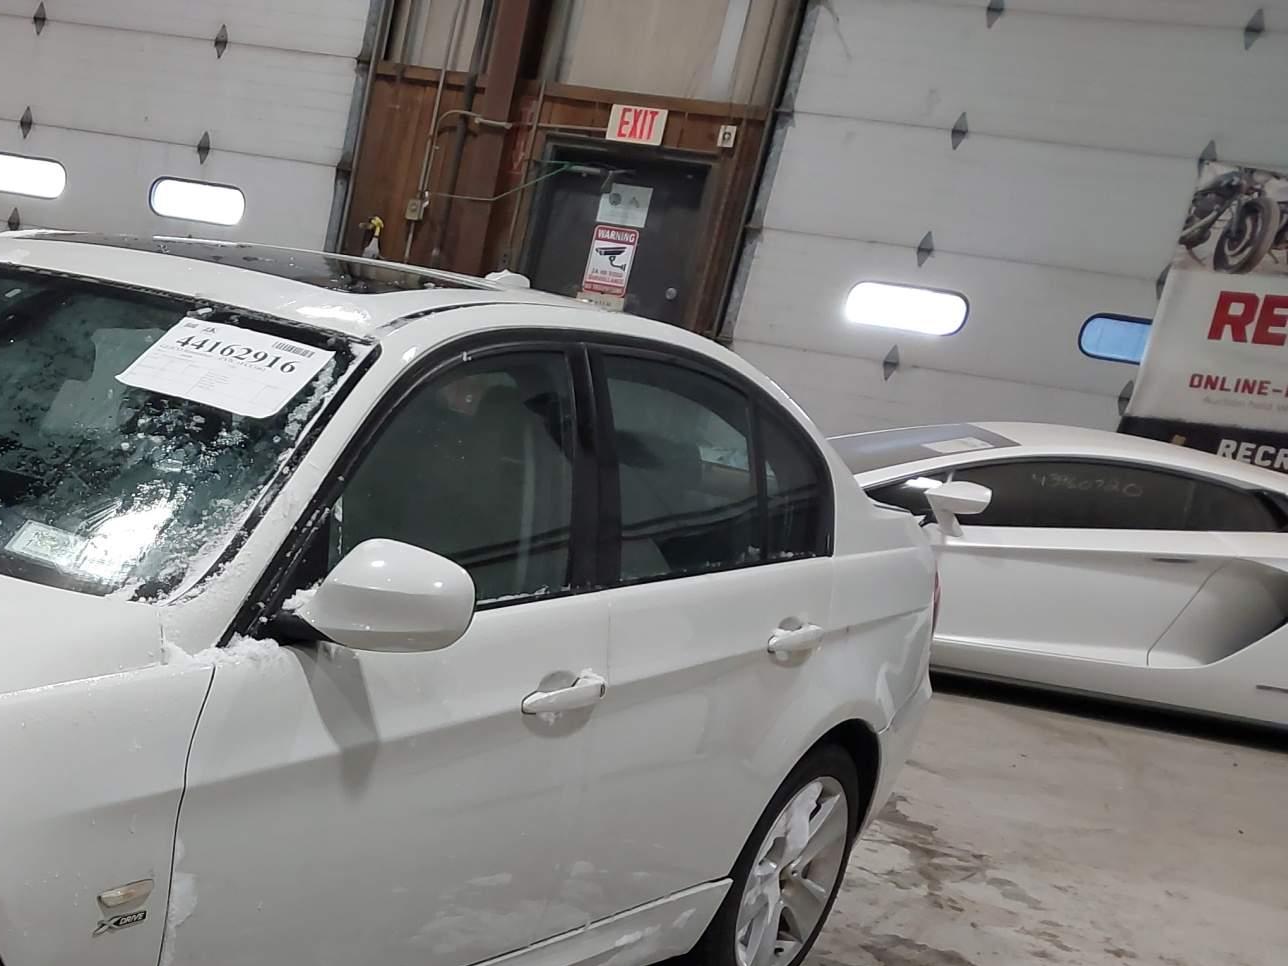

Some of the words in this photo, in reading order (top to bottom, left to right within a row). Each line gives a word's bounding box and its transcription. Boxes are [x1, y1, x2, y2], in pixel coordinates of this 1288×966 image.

[616, 107, 659, 140] EXIT
[597, 228, 636, 243] WARNING
[176, 335, 301, 374] 44162916
[1189, 372, 1288, 398] ONLINE-
